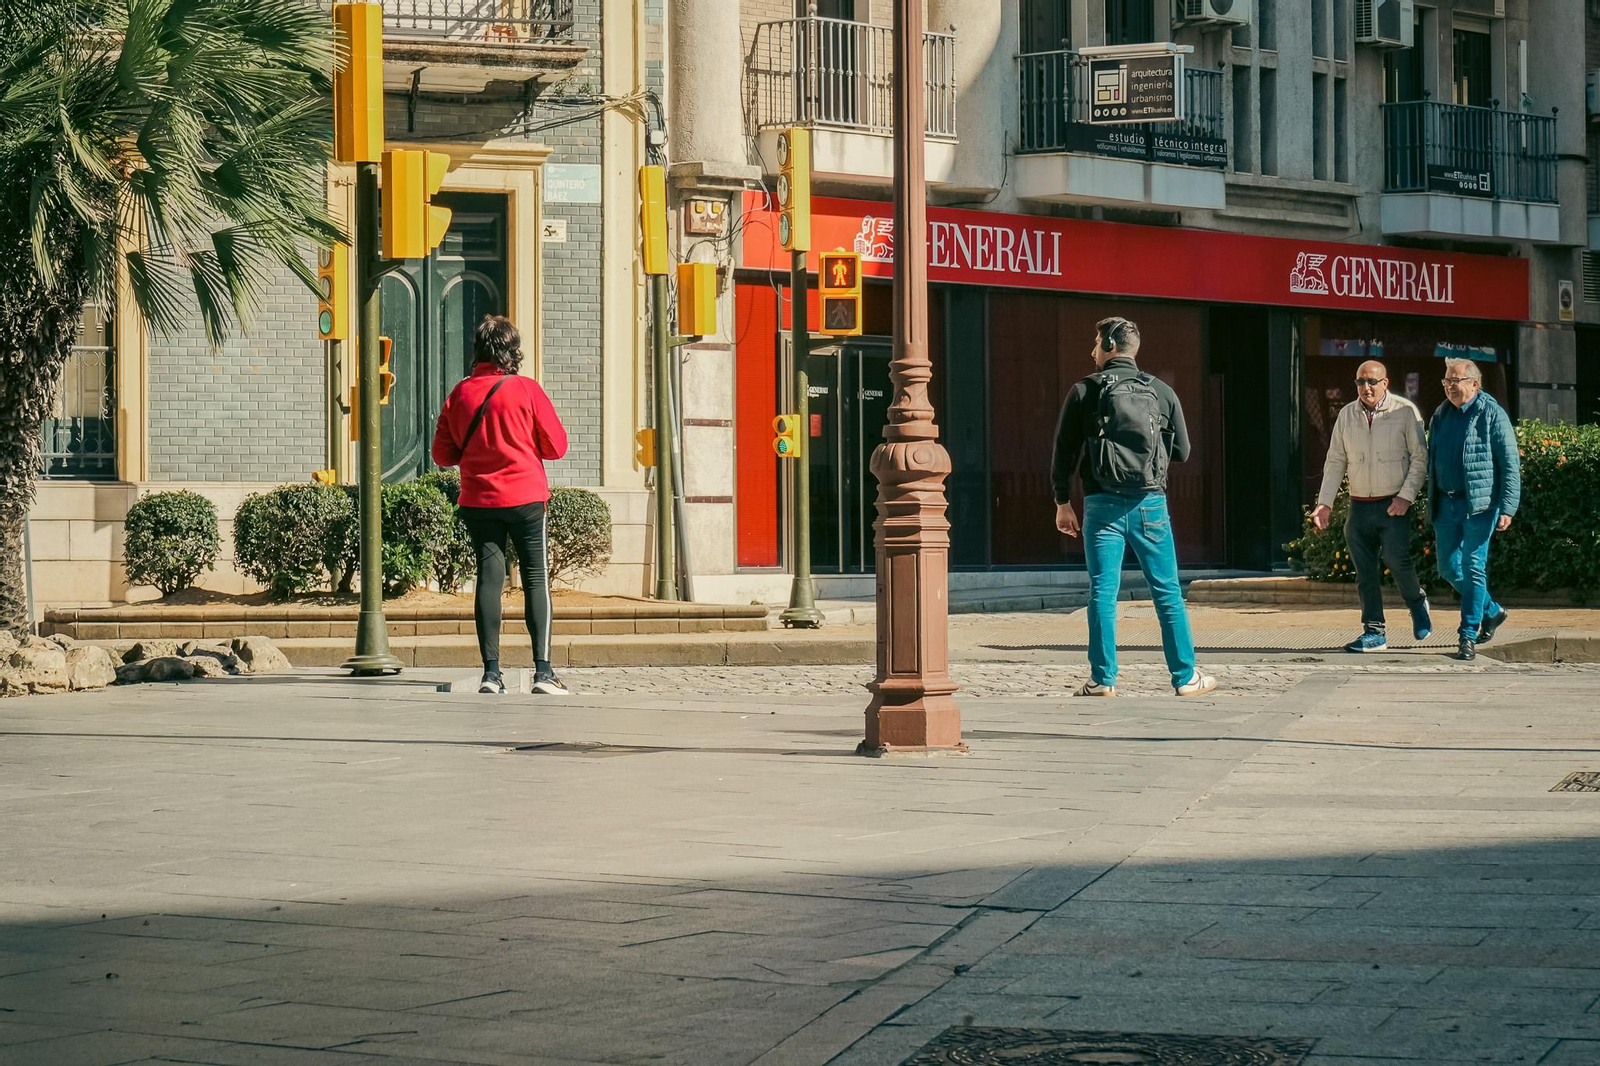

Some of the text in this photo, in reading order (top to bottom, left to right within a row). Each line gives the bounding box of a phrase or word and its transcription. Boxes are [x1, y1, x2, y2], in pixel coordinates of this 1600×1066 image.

[1131, 68, 1173, 79] arquitectura
[1131, 80, 1173, 92] ingeniería
[1131, 94, 1173, 103] urbanismo
[1109, 132, 1227, 155] estudio técnico integral
[547, 179, 586, 190] QUINTERO
[926, 221, 1062, 276] ENERALI
[1331, 255, 1454, 304] GENERALI
